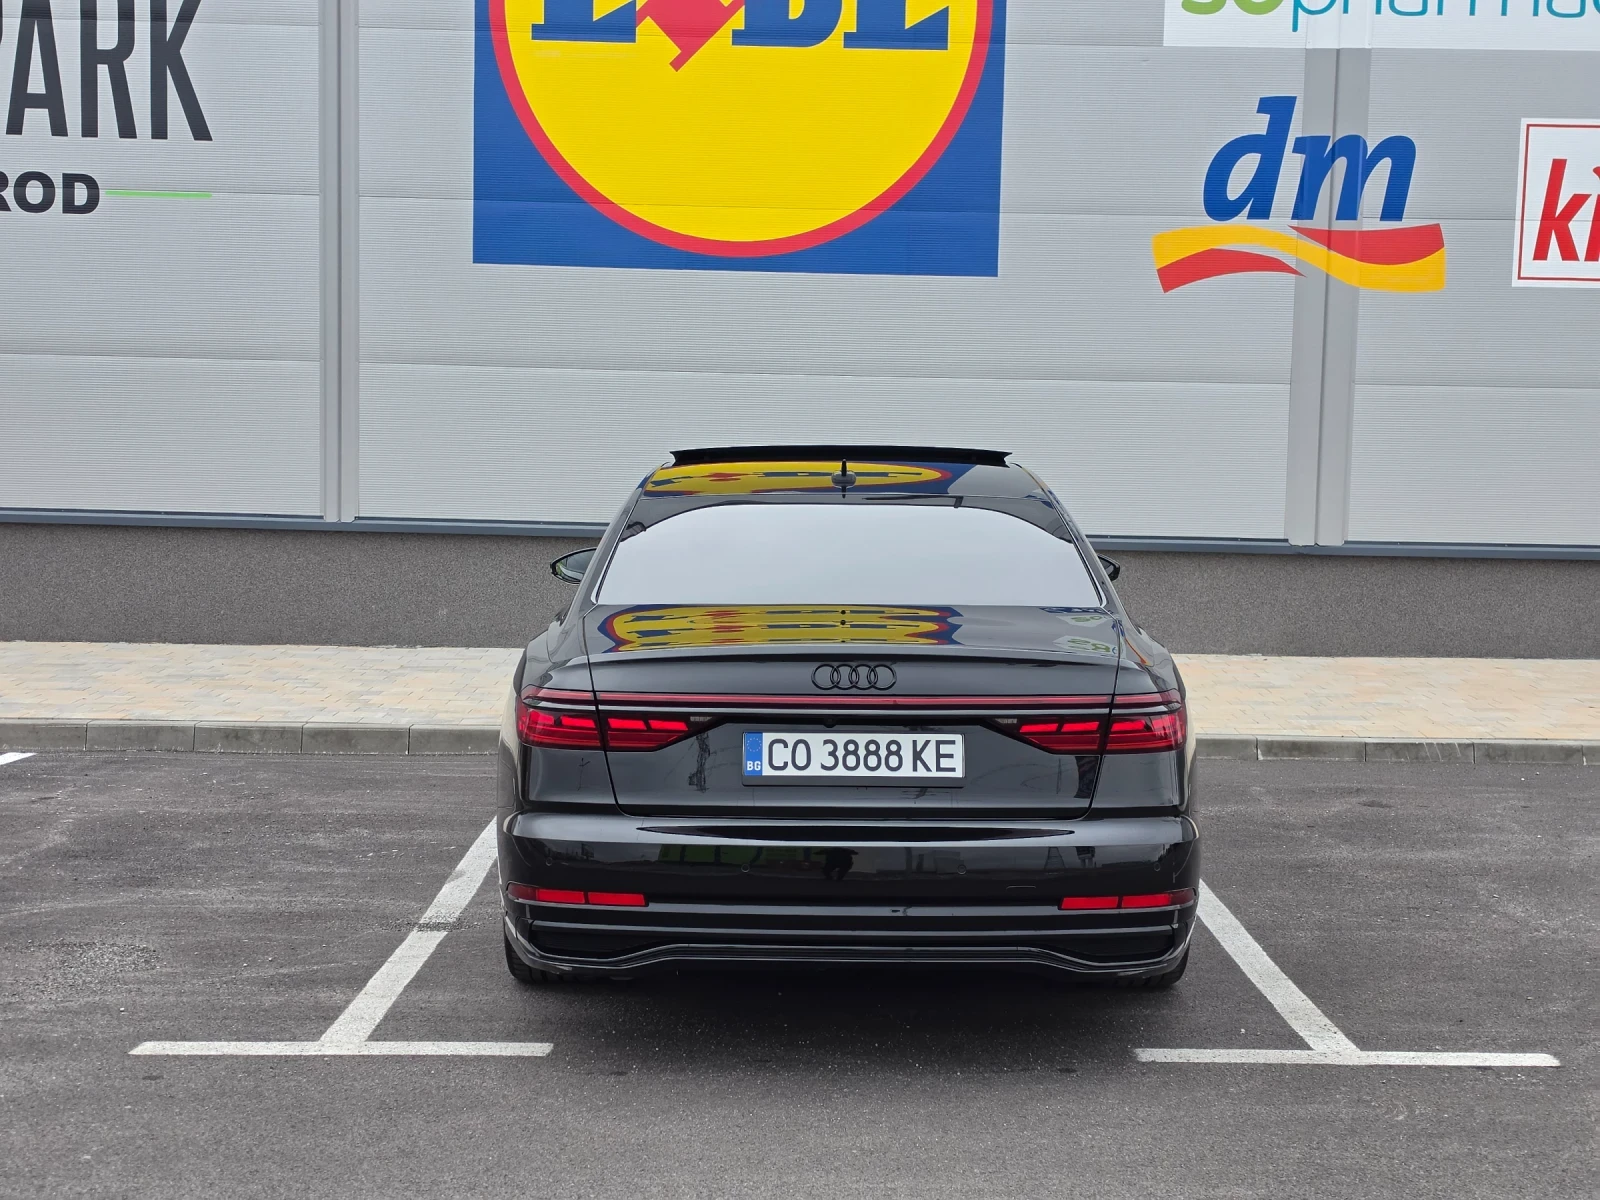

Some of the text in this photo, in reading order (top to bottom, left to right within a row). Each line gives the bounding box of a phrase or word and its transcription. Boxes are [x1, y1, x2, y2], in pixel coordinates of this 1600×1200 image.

[0, 0, 213, 141] ARK
[1203, 96, 1417, 222] dm
[746, 760, 761, 771] BG
[820, 739, 903, 772] 3888
[912, 739, 956, 773] KE
